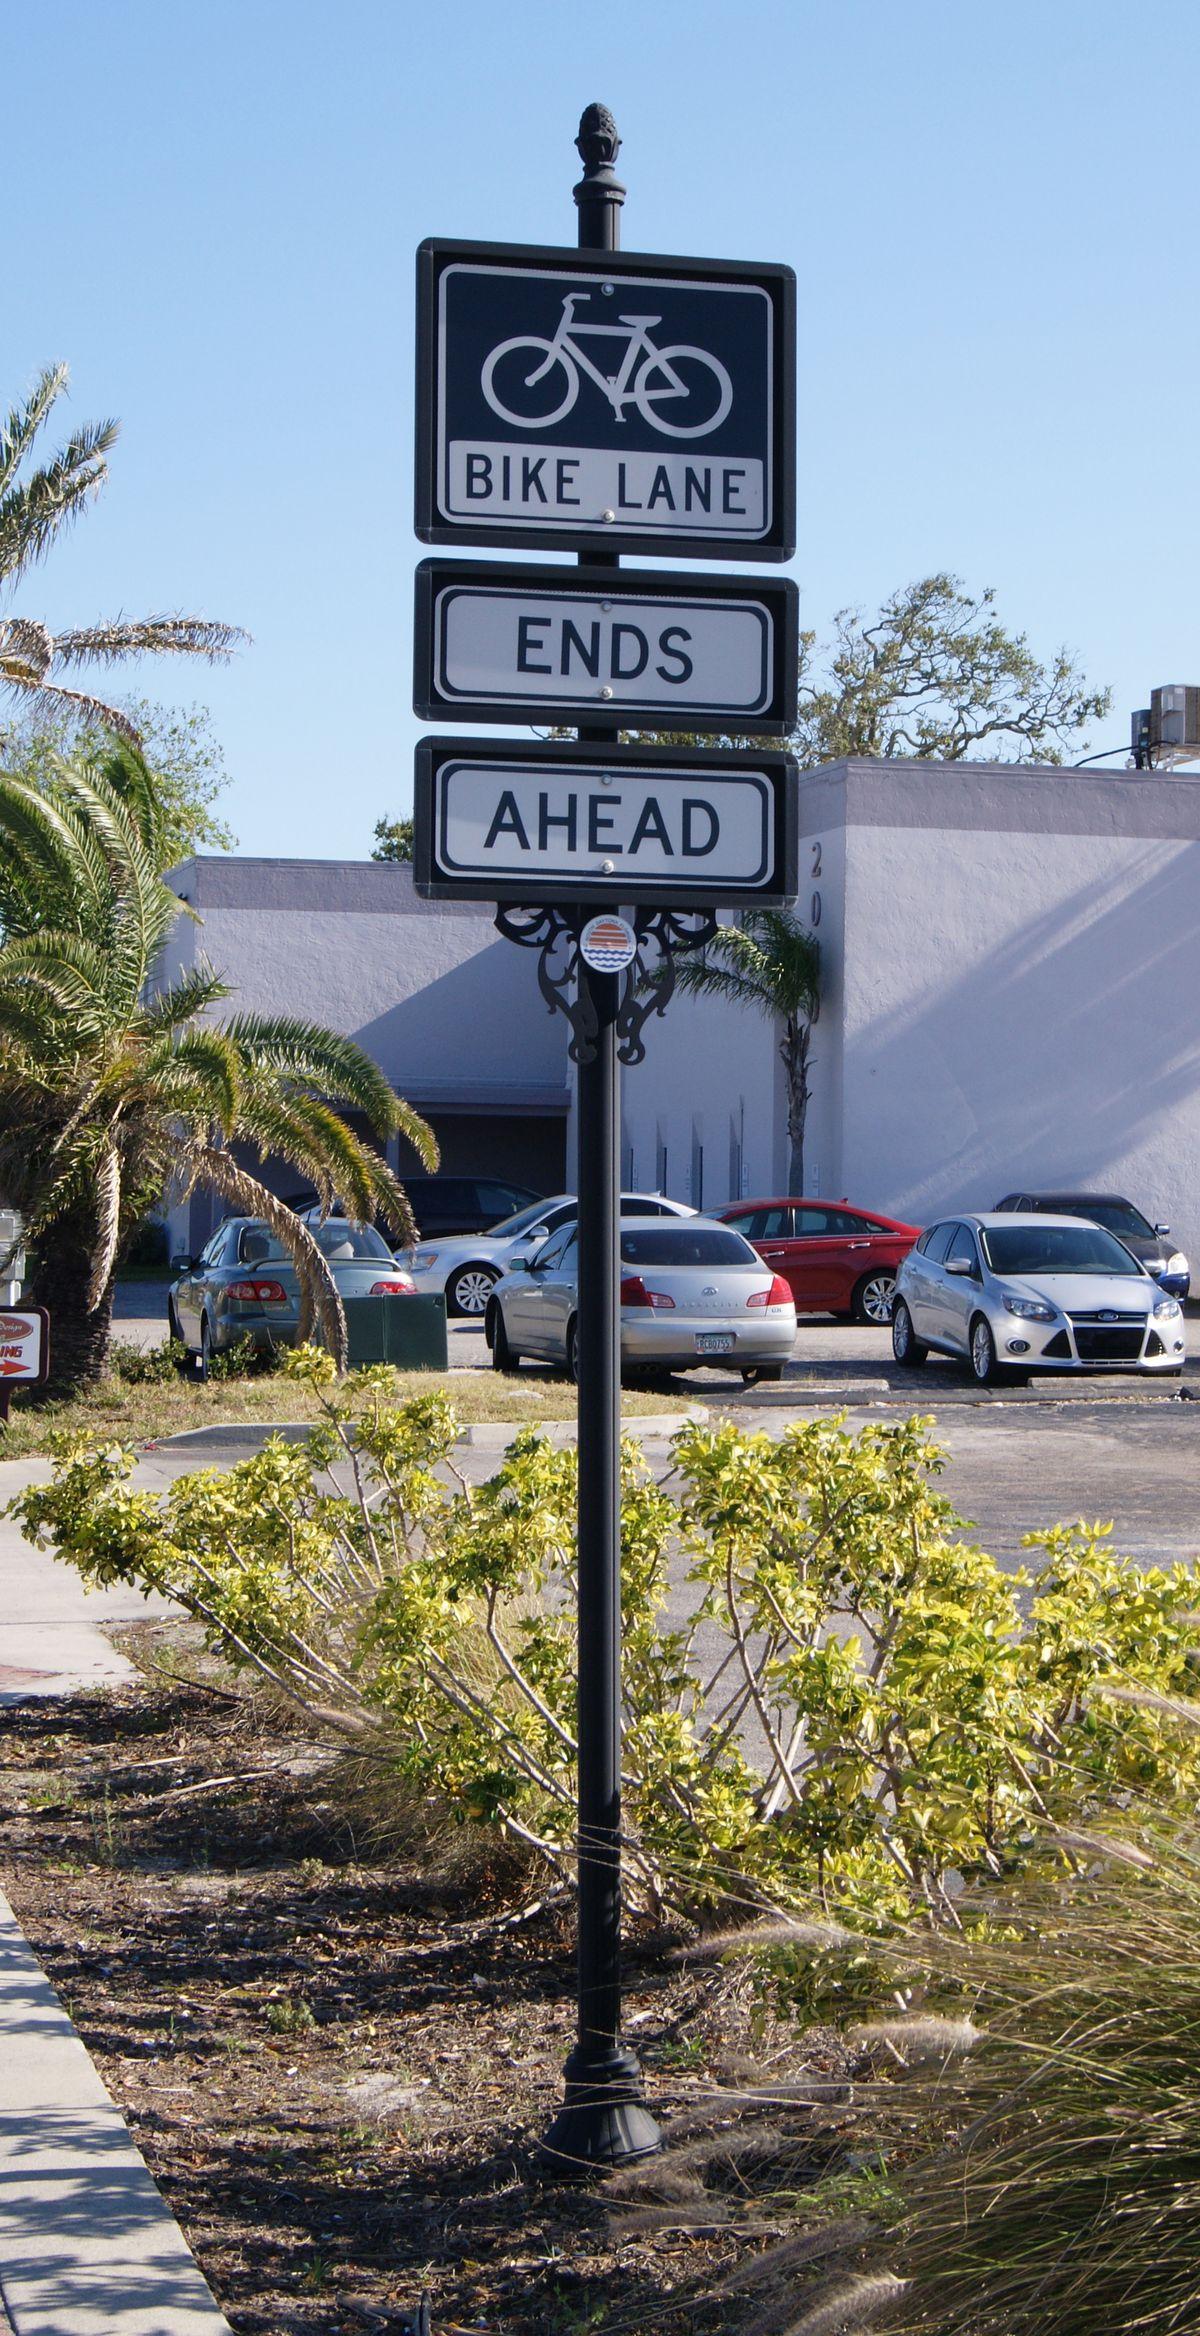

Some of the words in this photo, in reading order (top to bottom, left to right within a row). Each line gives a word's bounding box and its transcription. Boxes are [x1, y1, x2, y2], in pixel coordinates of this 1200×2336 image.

[465, 453, 580, 505] BIKE
[617, 462, 746, 515] LANE
[517, 616, 693, 684] ENDS
[483, 790, 720, 857] AHEAD
